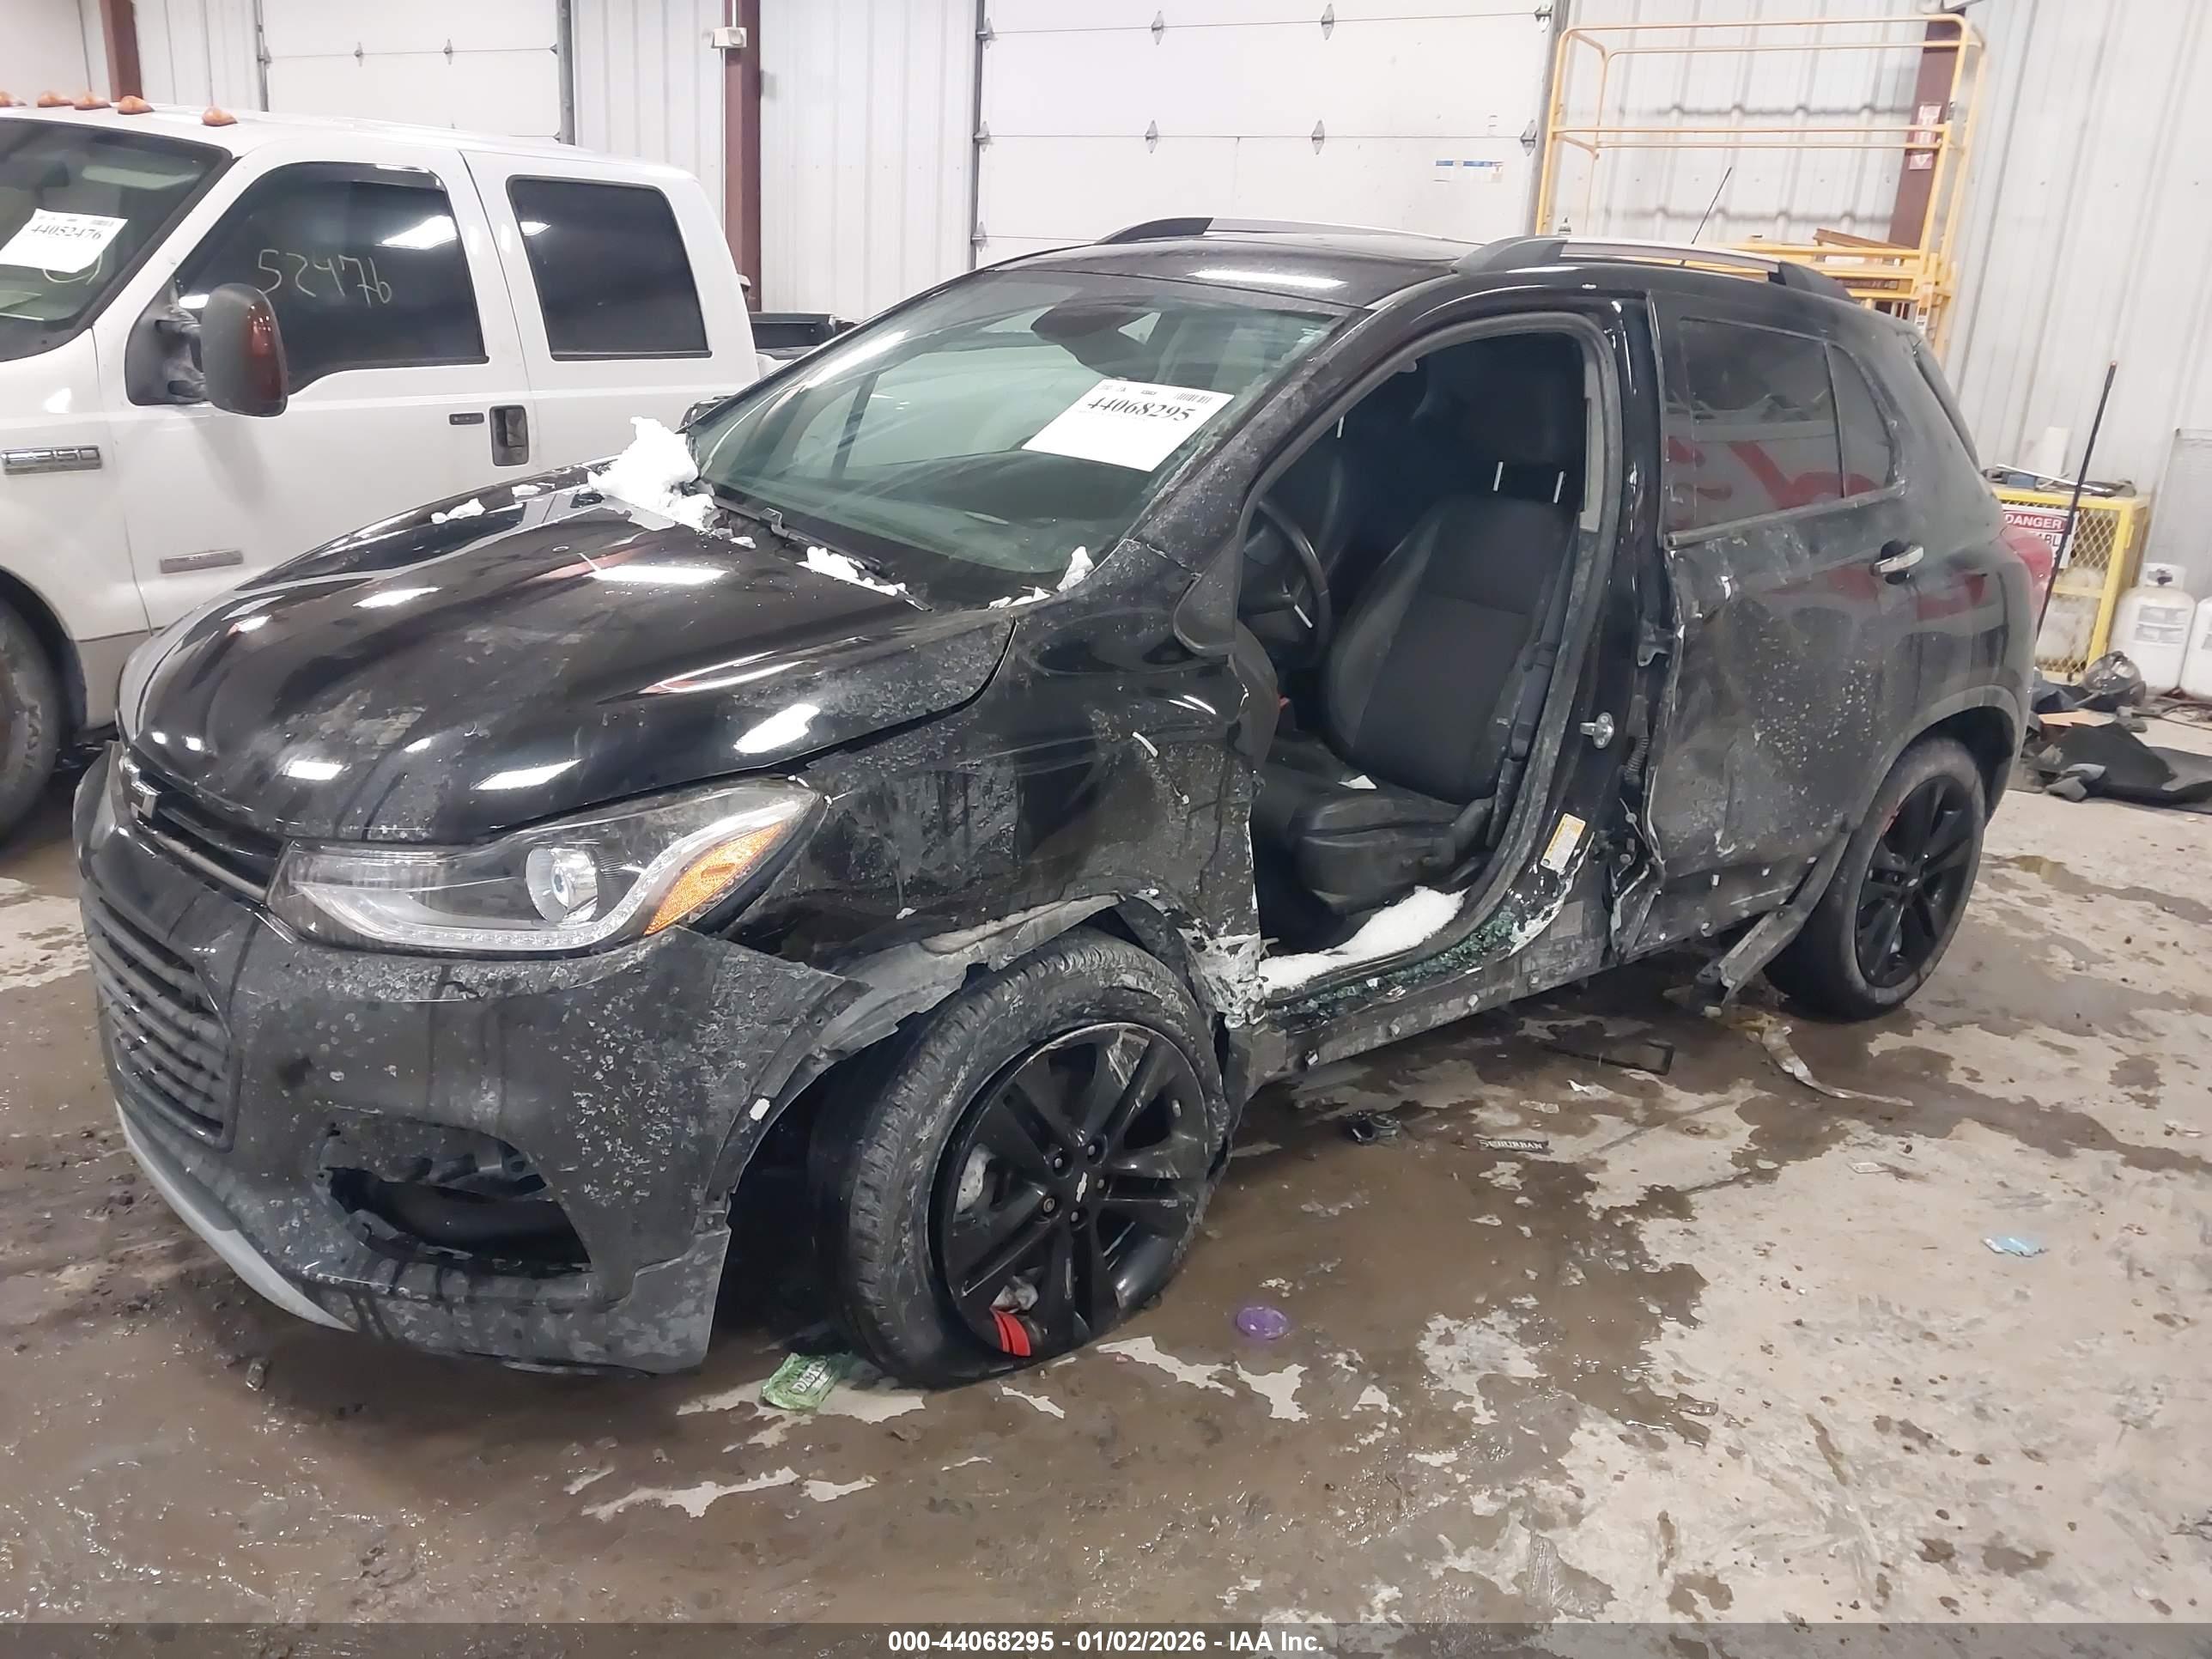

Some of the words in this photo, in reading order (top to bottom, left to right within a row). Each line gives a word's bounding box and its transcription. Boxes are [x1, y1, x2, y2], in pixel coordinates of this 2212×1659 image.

[30, 224, 103, 240] 44052476
[258, 248, 392, 308] 52476
[1087, 396, 1196, 422] 44068295
[2005, 514, 2062, 529] DANGER
